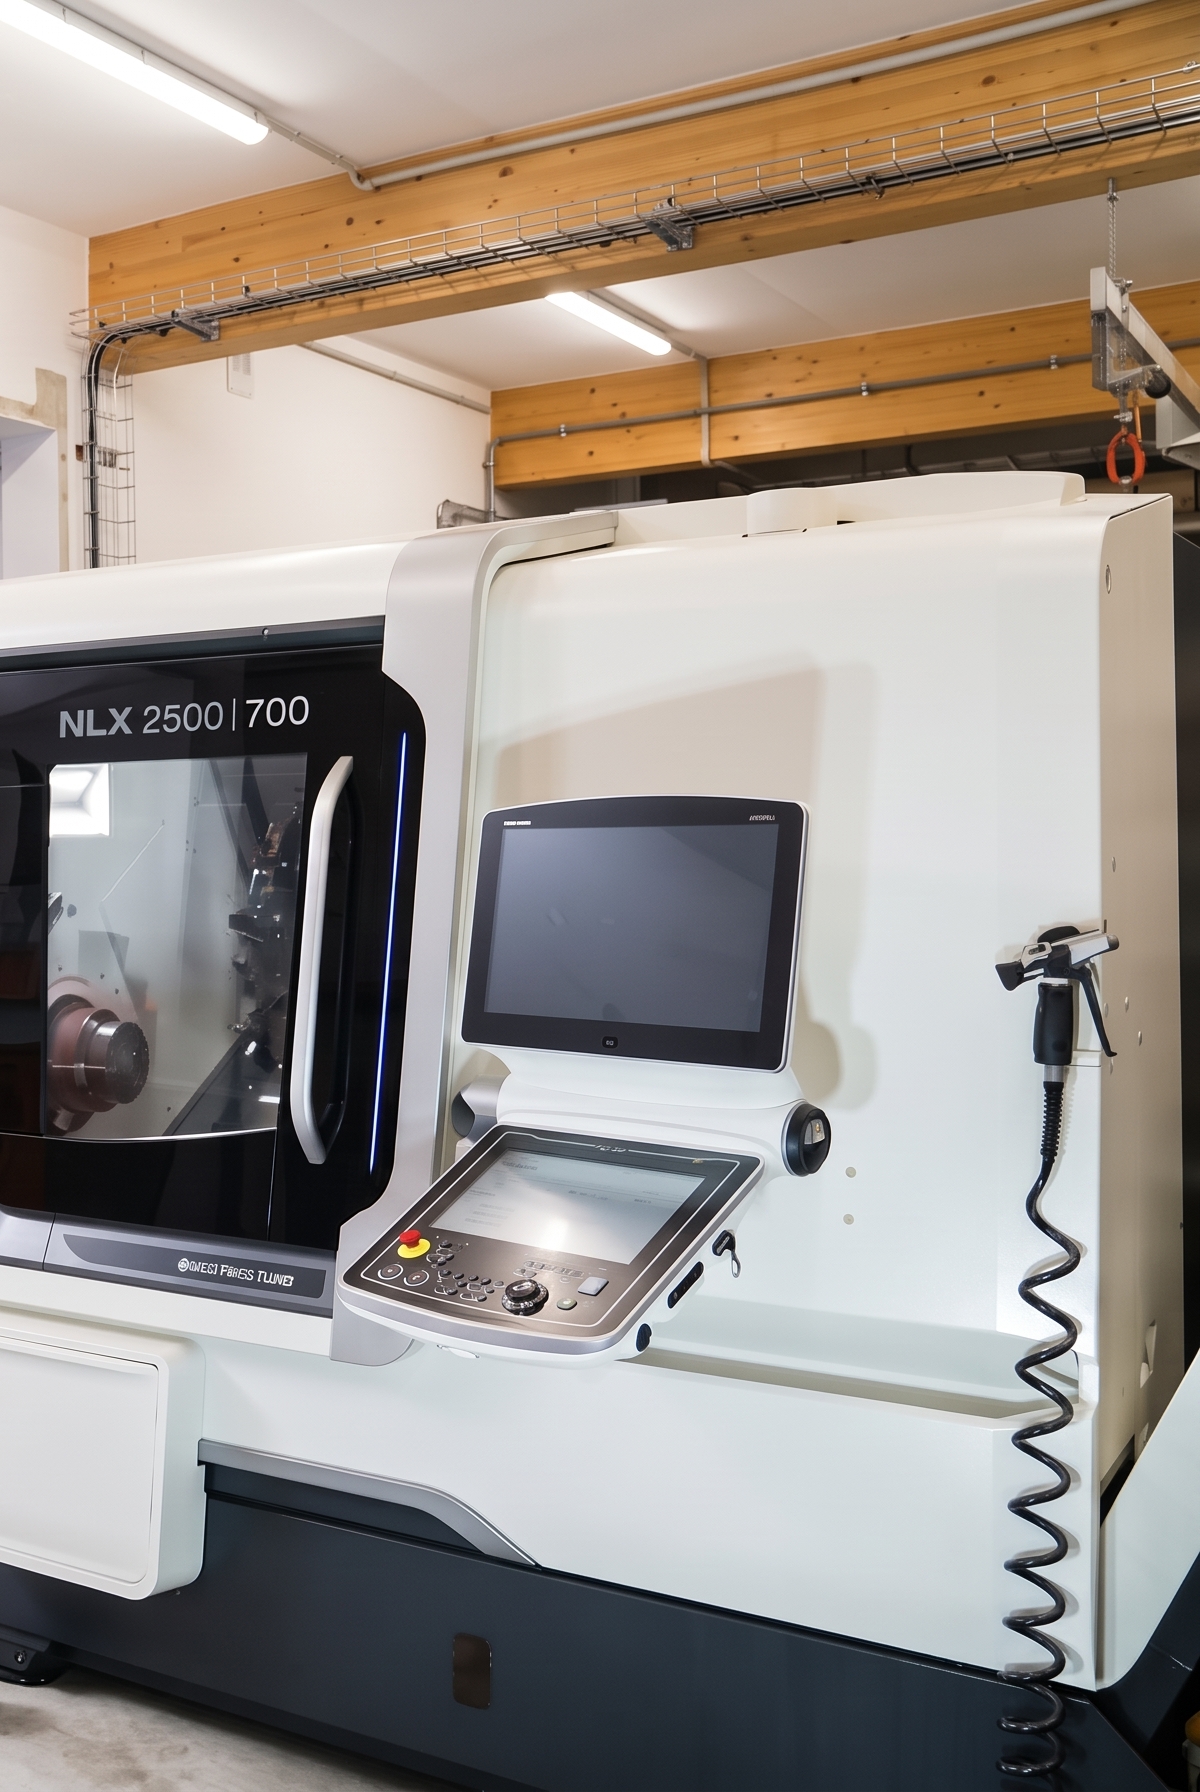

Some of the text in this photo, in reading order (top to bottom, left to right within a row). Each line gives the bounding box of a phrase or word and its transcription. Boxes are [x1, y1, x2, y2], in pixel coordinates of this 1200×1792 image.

[59, 706, 133, 738] NLX
[142, 701, 224, 734] 2500
[245, 695, 310, 728] 700
